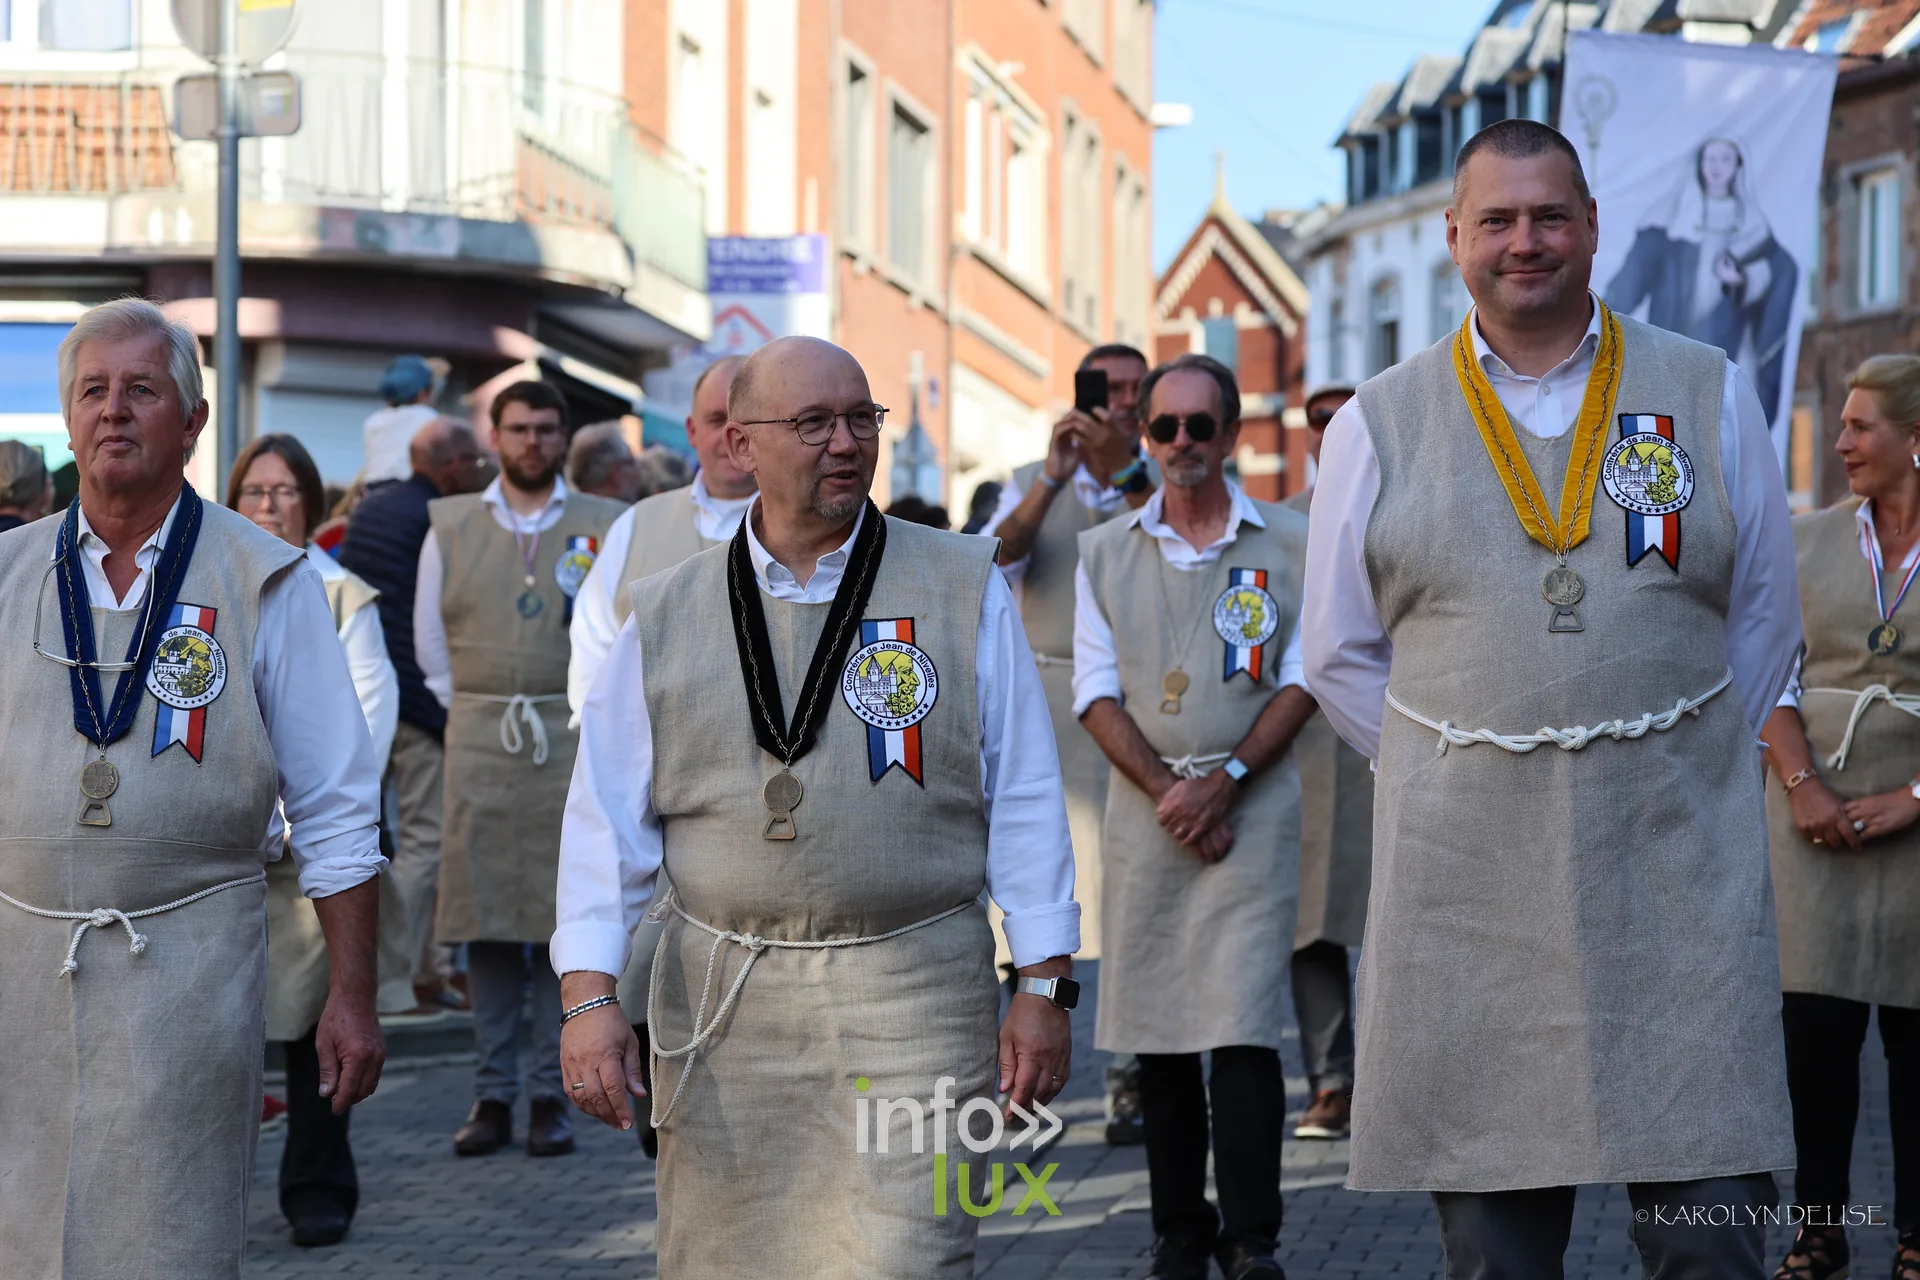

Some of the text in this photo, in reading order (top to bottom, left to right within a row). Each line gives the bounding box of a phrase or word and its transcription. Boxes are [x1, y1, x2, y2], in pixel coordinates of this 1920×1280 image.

[1626, 436, 1638, 445] de
[1640, 434, 1664, 444] Jean
[1665, 441, 1677, 451] de
[1676, 450, 1693, 484] Nivelles
[168, 628, 225, 680] de Jean de Nivelles
[844, 642, 935, 692] Confrérie de Jean de Nivelles
